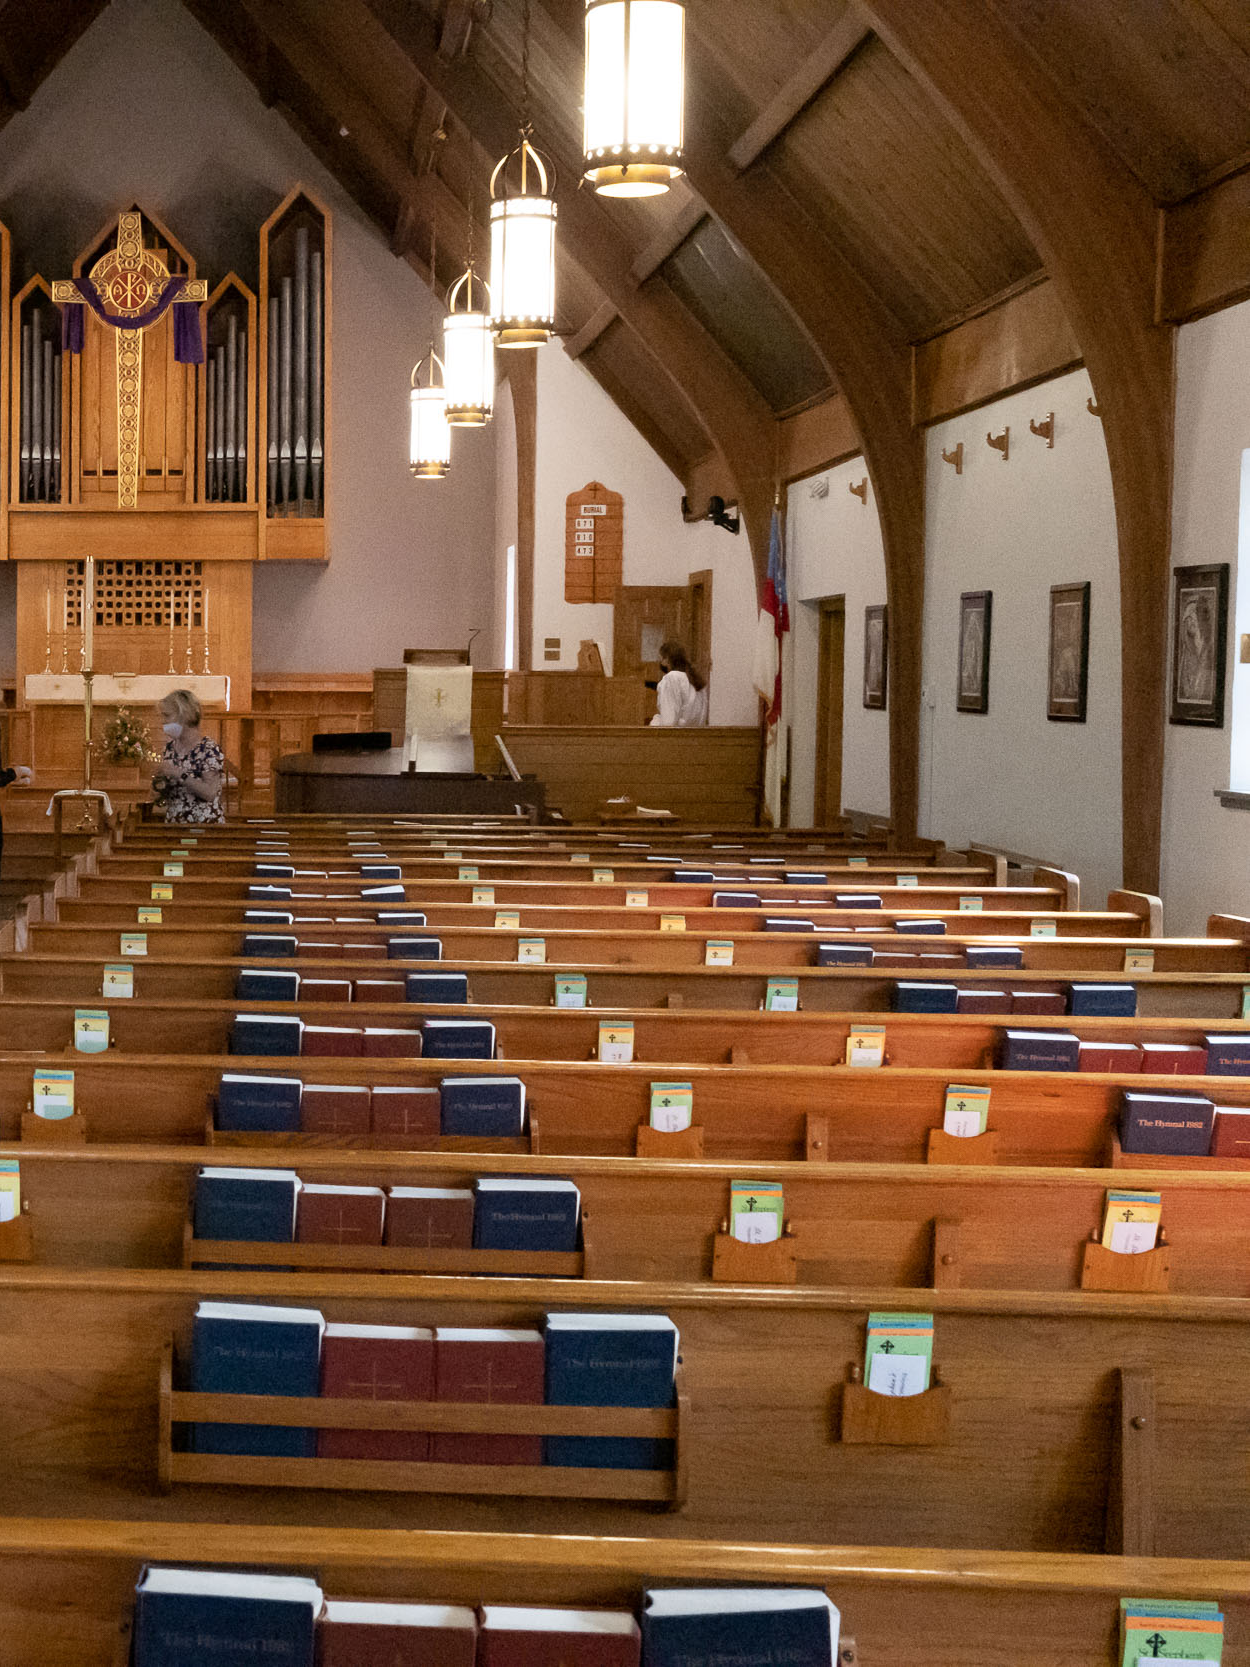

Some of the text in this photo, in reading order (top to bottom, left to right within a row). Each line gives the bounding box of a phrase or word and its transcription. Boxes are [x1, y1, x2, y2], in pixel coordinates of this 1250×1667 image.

[1138, 1119, 1154, 1127] The
[1155, 1120, 1185, 1129] Hymnal
[492, 1212, 510, 1221] The
[161, 1632, 193, 1648] The
